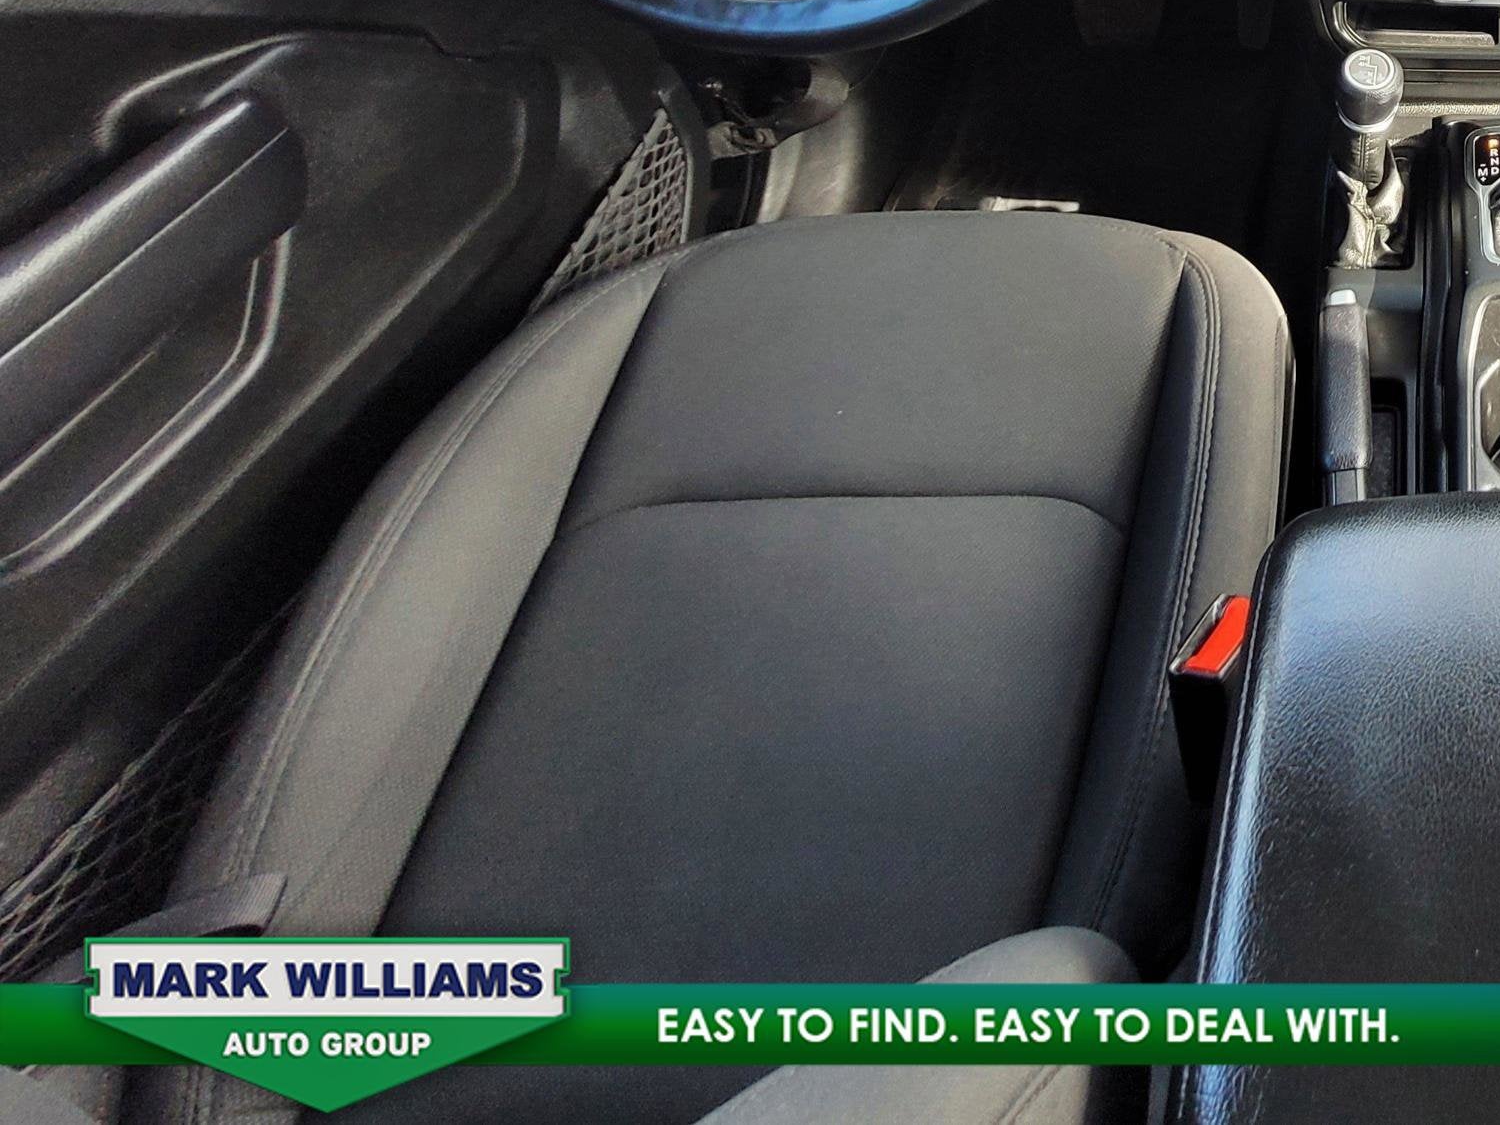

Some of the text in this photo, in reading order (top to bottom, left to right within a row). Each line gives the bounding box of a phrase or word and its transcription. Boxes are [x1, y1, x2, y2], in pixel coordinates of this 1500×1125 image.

[1490, 148, 1499, 156] R
[1490, 157, 1500, 166] N
[1478, 167, 1489, 177] M
[1490, 166, 1500, 175] D
